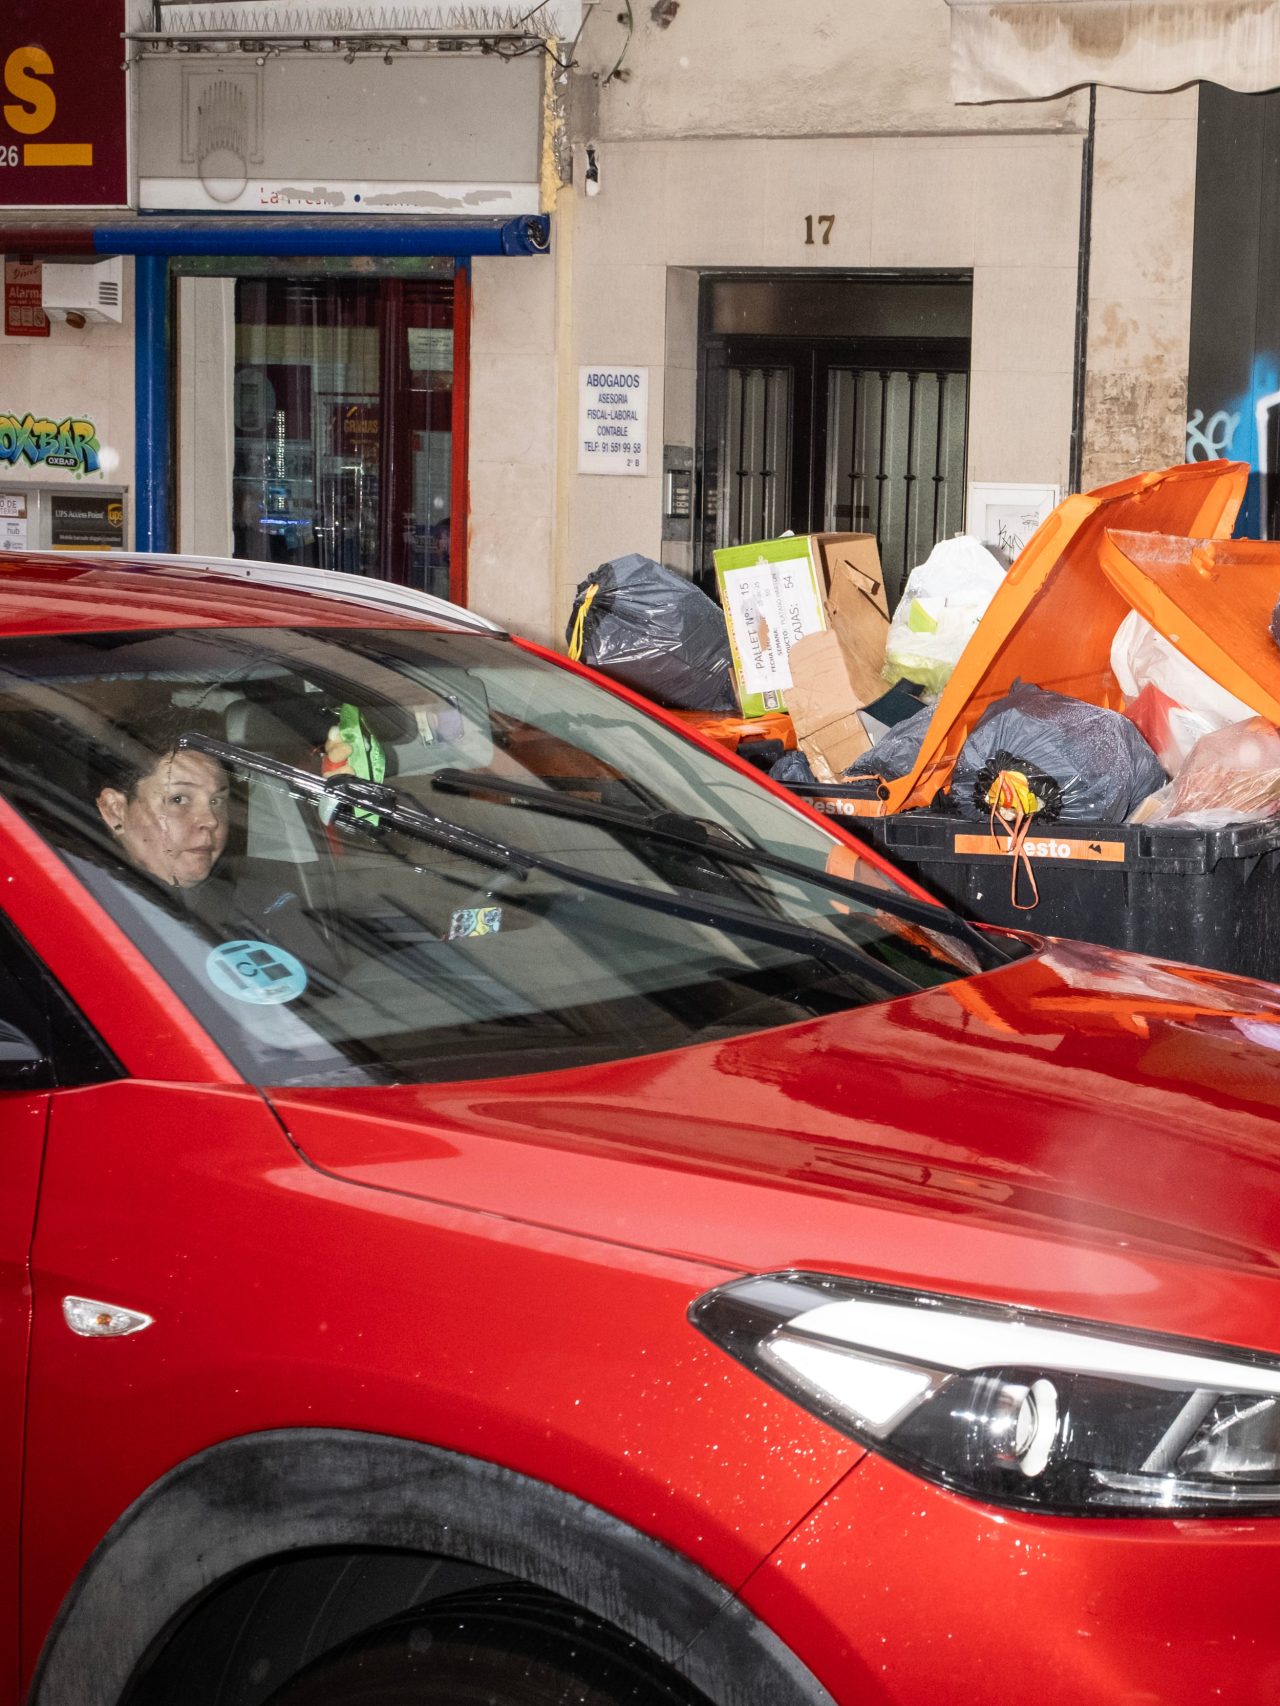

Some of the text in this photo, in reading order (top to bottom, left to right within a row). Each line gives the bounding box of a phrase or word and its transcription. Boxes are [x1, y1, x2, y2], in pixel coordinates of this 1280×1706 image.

[4, 46, 56, 135] S
[804, 214, 835, 245] 17
[587, 373, 640, 388] ABOGADOS
[598, 393, 628, 404] ASESORIA
[587, 409, 639, 421] FISCAL-LABORAL
[597, 425, 628, 437] CONTABLE
[602, 442, 609, 452] 91
[623, 442, 631, 453] 99
[48, 457, 75, 466] OXBAR
[739, 582, 750, 596] 15
[783, 575, 804, 641] CAJAS: 54
[749, 630, 764, 669] PALLET
